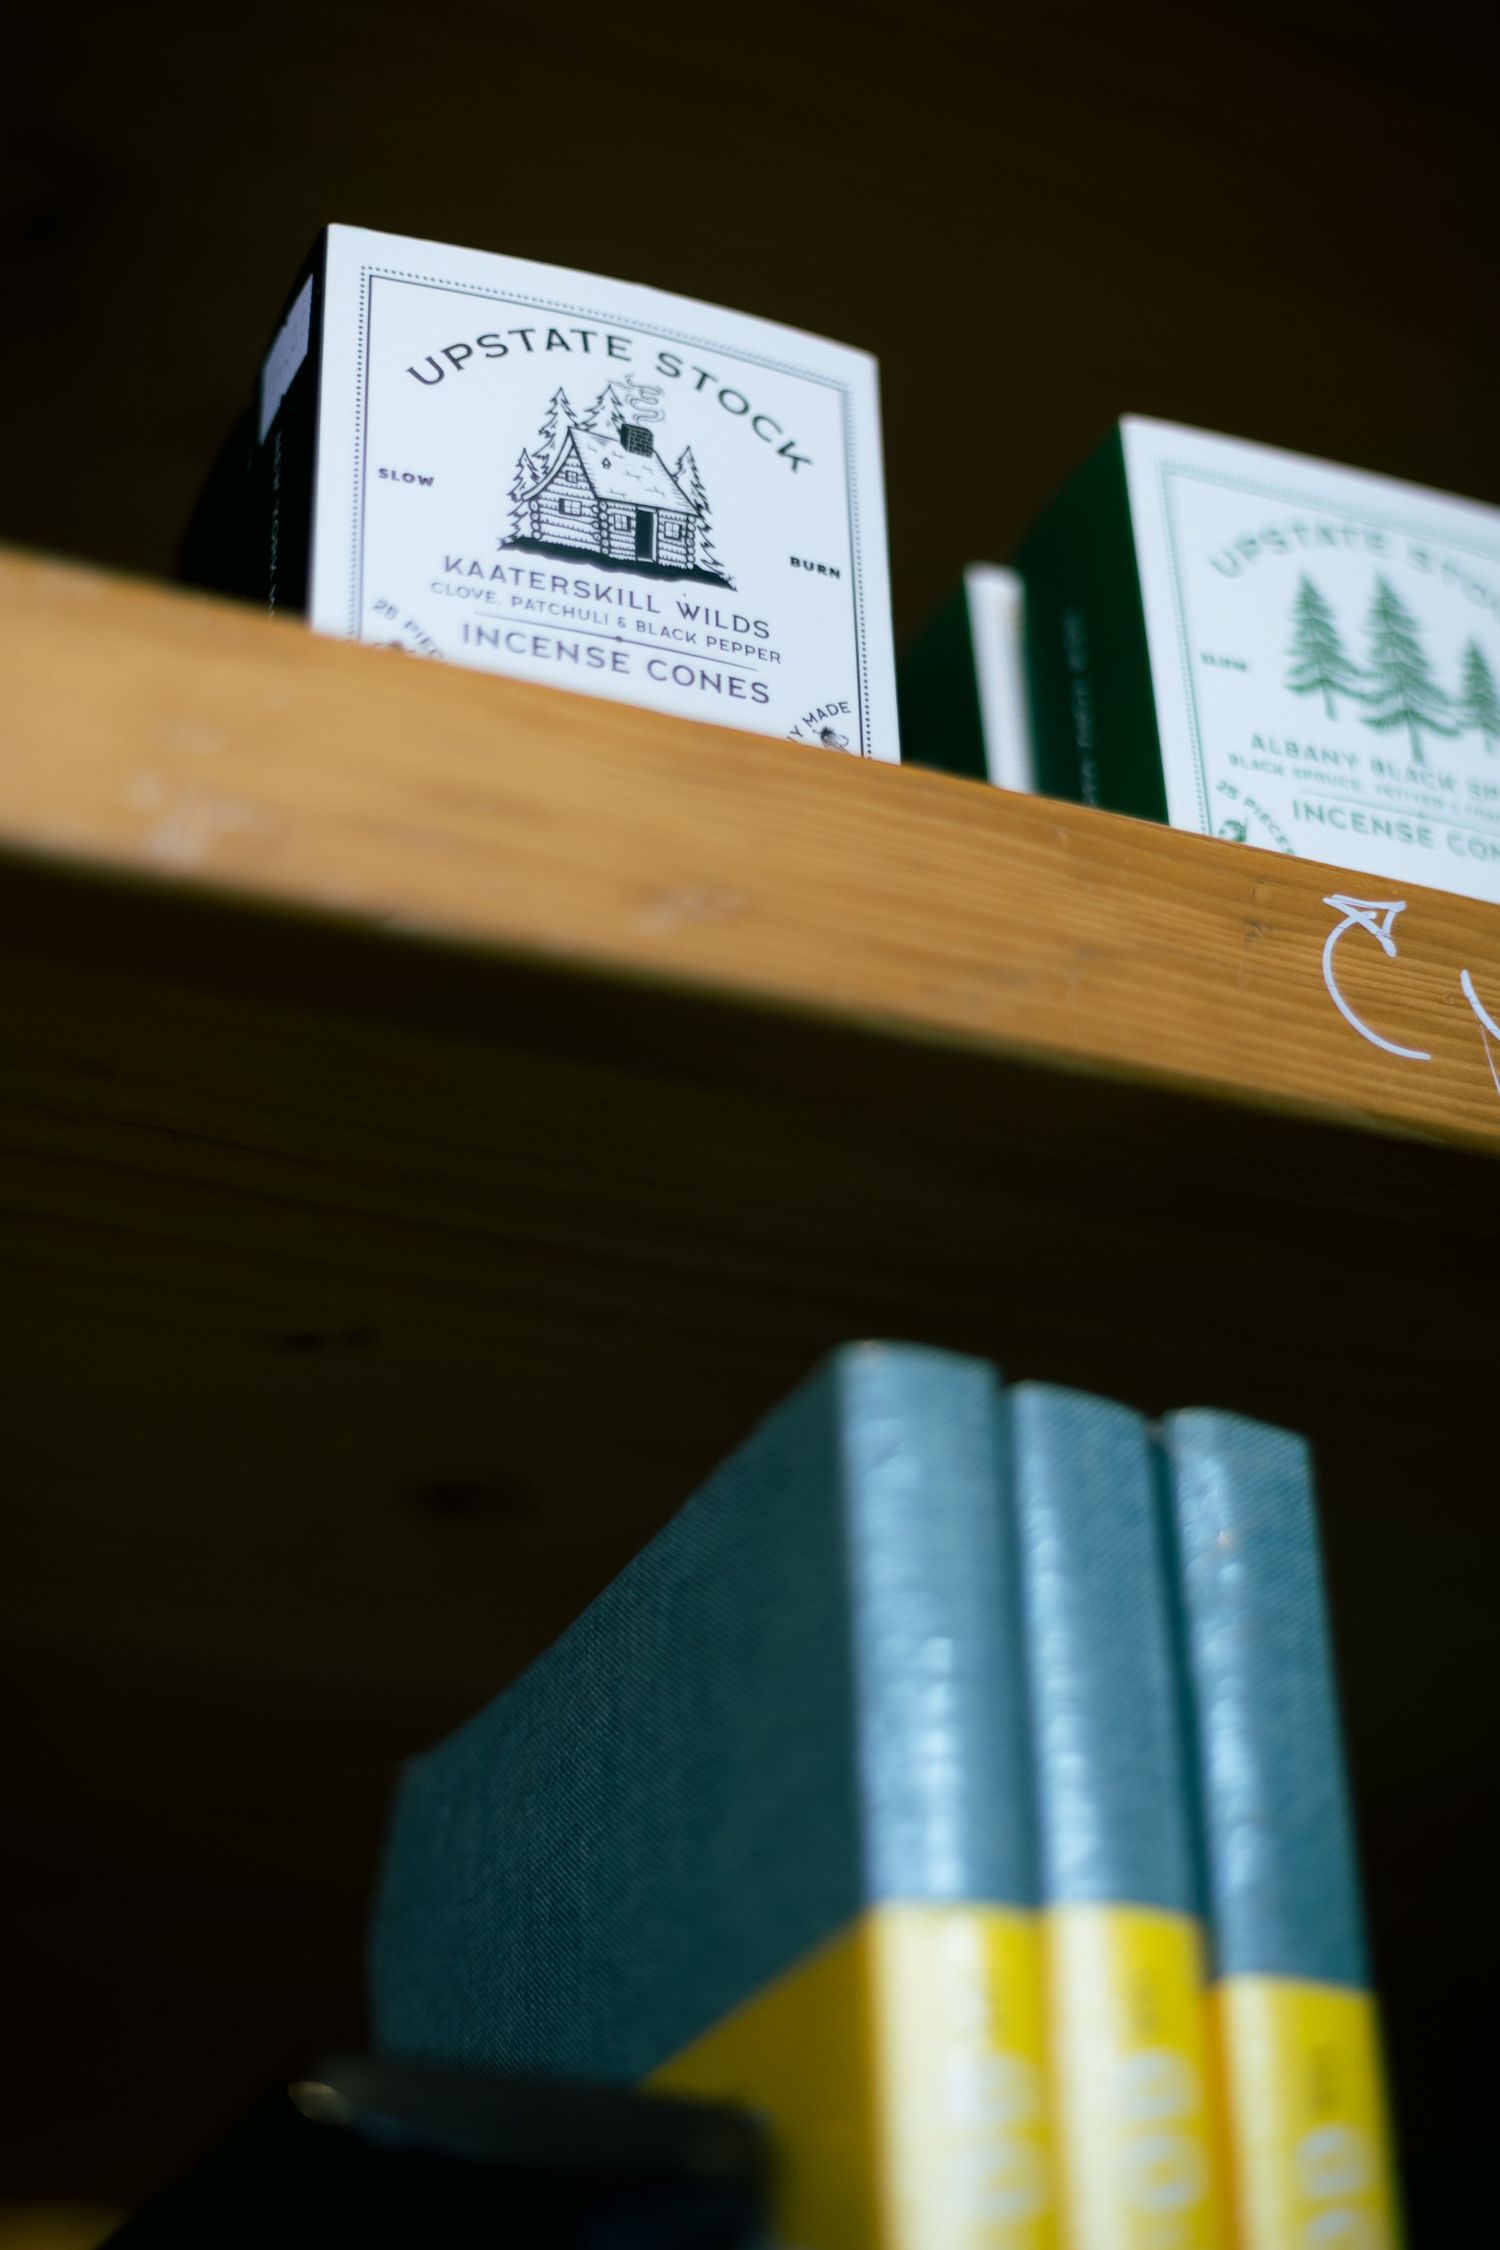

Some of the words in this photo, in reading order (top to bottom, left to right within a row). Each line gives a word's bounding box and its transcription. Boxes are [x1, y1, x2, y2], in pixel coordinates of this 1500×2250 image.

[406, 328, 633, 386] UPSTATE
[655, 352, 814, 474] STOCK
[378, 467, 435, 488] SLOW
[789, 556, 842, 580] BURN
[1207, 518, 1391, 579] UPSTATE
[444, 555, 661, 615] KAATERSKILL
[675, 600, 771, 640] WILDS
[510, 595, 609, 626] PATCHULI
[617, 616, 627, 628] &
[636, 619, 697, 645] BLACK
[706, 635, 782, 664] PEPPER
[462, 622, 631, 675] INCENSE
[646, 658, 771, 704] CONES
[802, 701, 852, 728] MADE
[1250, 732, 1358, 769] ALBANY
[1216, 779, 1239, 800] 25
[1292, 799, 1437, 851] INCENSE
